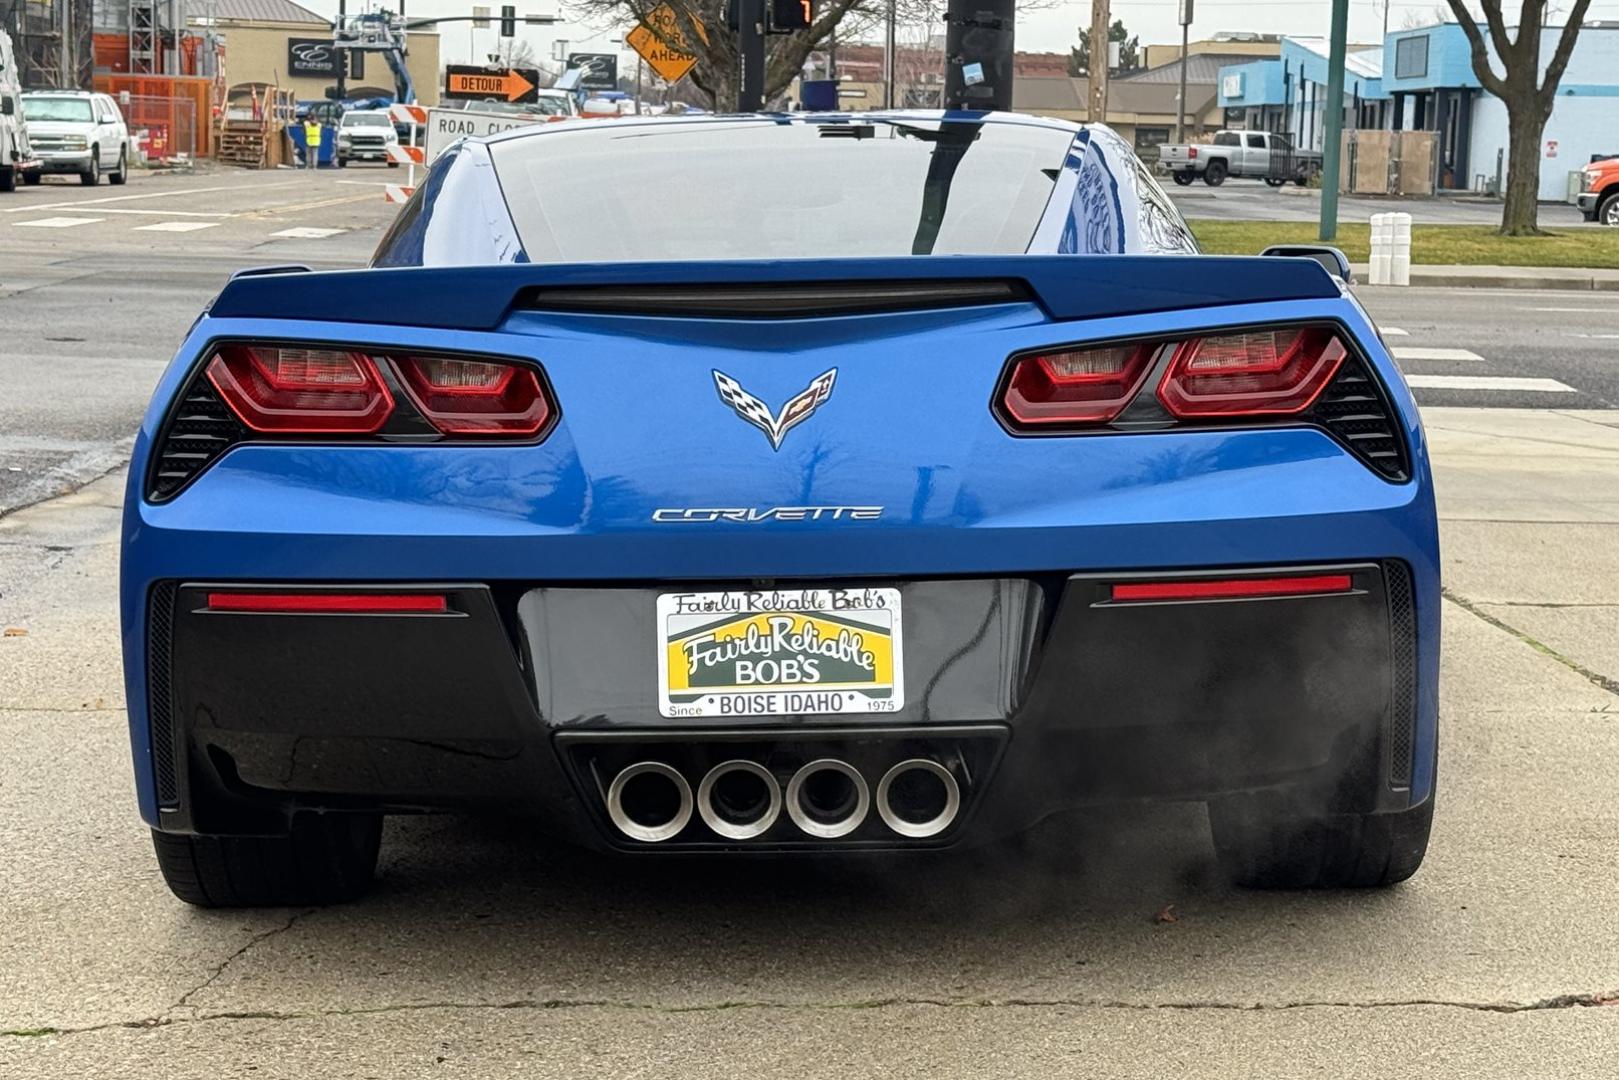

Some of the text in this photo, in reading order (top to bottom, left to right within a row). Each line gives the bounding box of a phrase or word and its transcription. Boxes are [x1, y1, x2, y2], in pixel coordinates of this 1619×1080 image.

[650, 50, 694, 61] AHEAD
[461, 77, 503, 92] DETOUR
[440, 119, 519, 135] ROAD CLO
[652, 506, 885, 522] CORVETTE
[672, 589, 886, 614] Fairly Reliable Bob's
[683, 616, 875, 675] Fairly Reliable
[735, 655, 821, 684] BOB'S
[669, 706, 703, 716] Since
[720, 693, 843, 714] BOISE IDAHO
[867, 701, 895, 711] 1975
